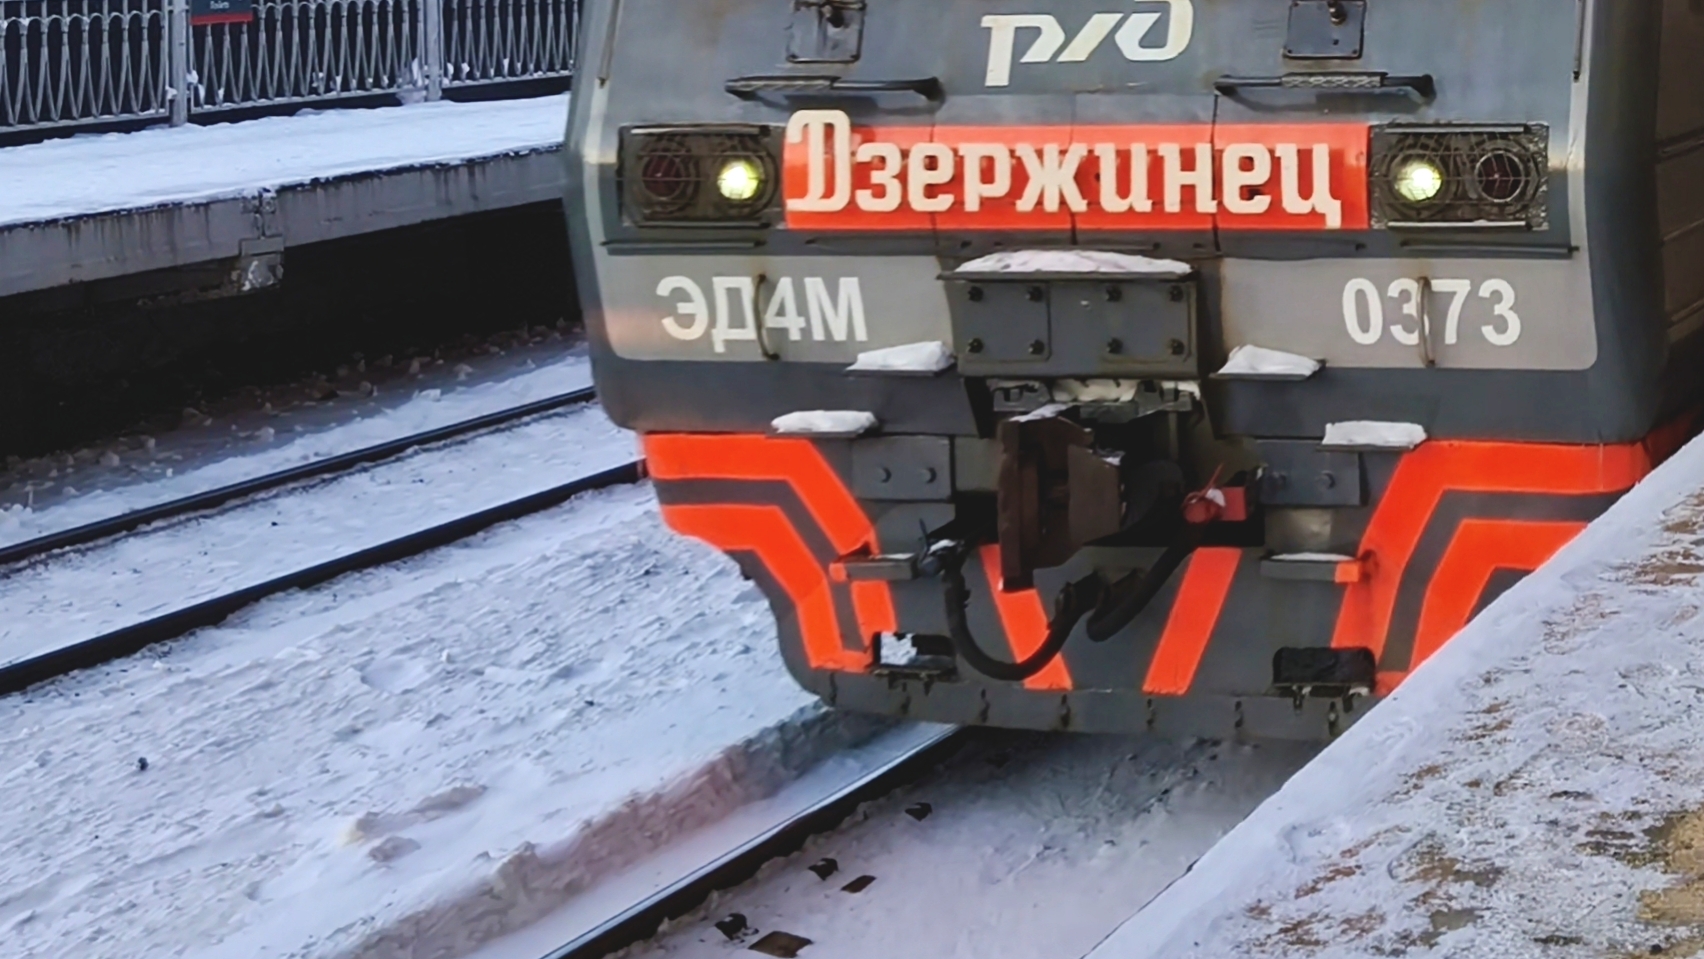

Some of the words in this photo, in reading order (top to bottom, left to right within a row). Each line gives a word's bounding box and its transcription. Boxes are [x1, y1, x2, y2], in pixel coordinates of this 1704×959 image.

[785, 109, 1342, 229] Дзержинец
[655, 275, 869, 353] ЭД4М
[1342, 277, 1521, 346] 0373
